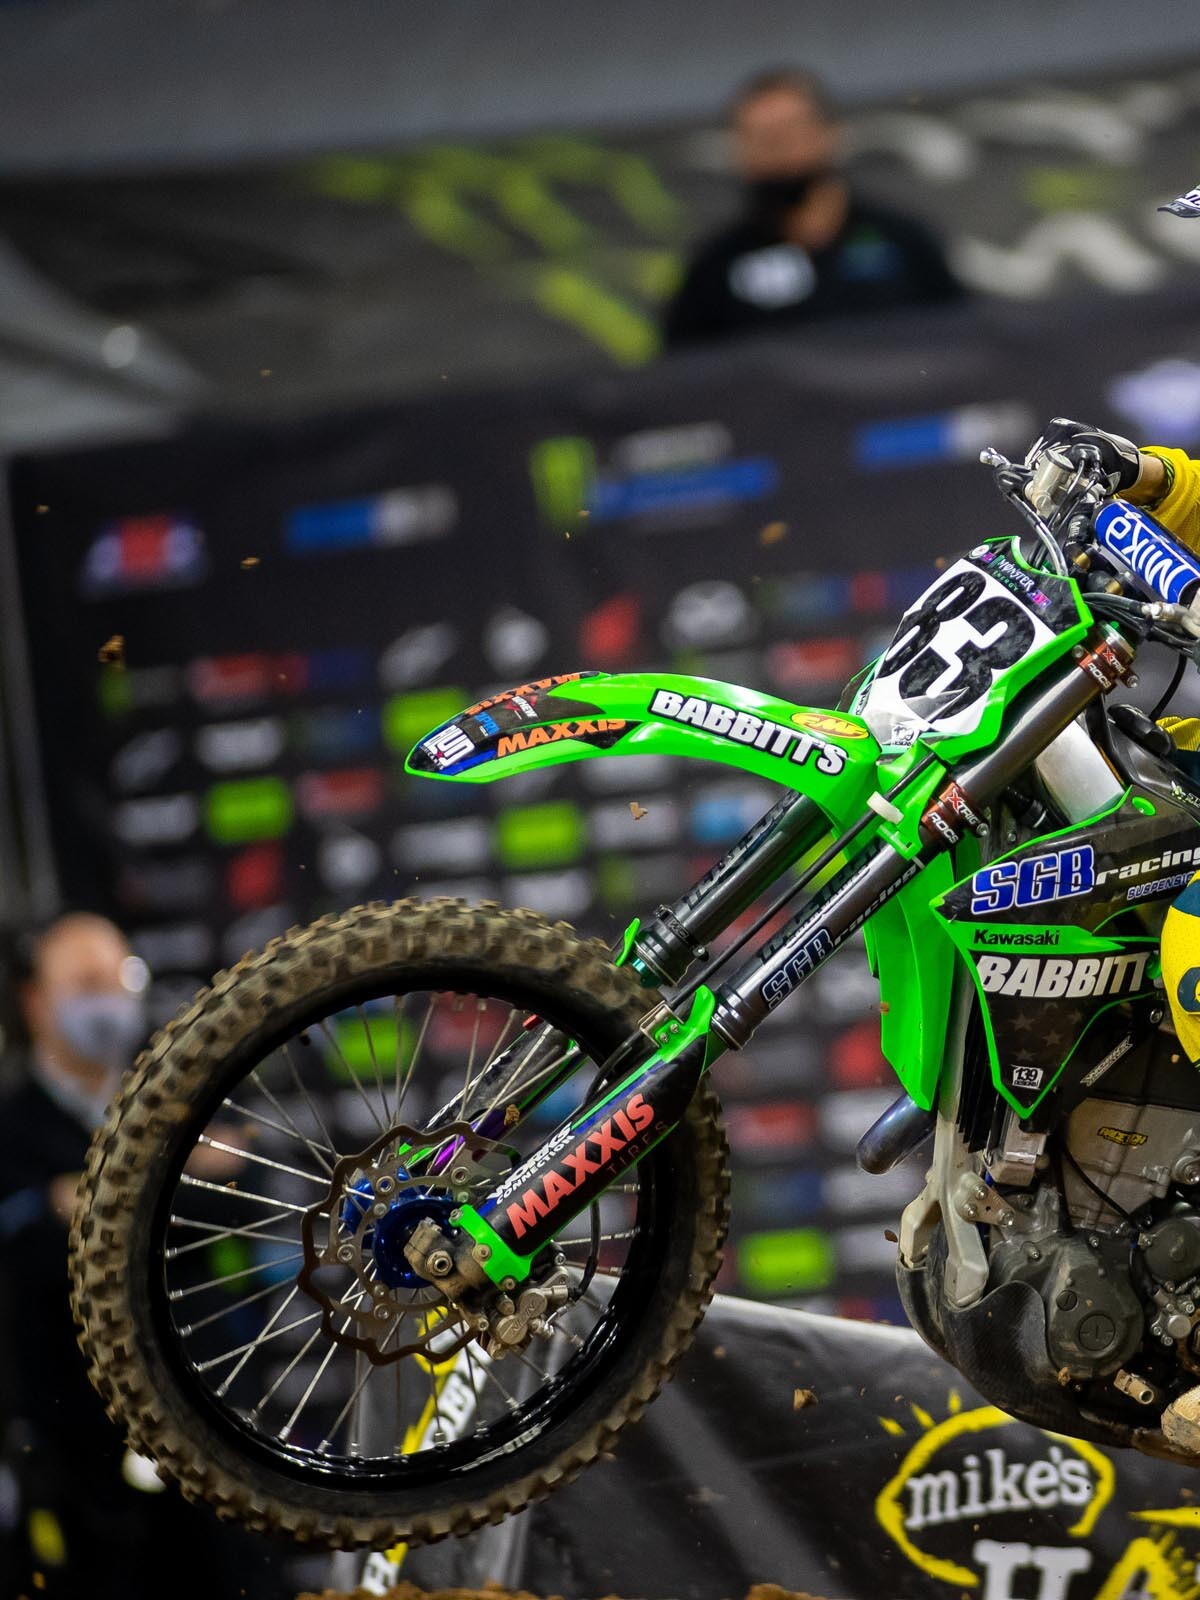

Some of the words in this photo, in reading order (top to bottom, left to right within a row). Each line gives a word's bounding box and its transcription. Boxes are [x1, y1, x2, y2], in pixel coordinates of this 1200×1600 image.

[1105, 514, 1192, 602] Mika
[876, 570, 1036, 720] 83
[497, 719, 627, 758] MAXXIS
[651, 689, 848, 775] BABBITT'S
[927, 811, 959, 844] ROCS
[947, 787, 979, 825] XTRIG
[971, 844, 1095, 915] SGB
[762, 928, 835, 1011] SGB
[973, 929, 1060, 946] Kawasaki
[486, 1122, 573, 1200] WORKS
[496, 1133, 576, 1205] CONNECTION
[506, 1093, 655, 1239] MAXXIS
[606, 1122, 668, 1175] TIRES
[904, 1446, 1093, 1530] mike's
